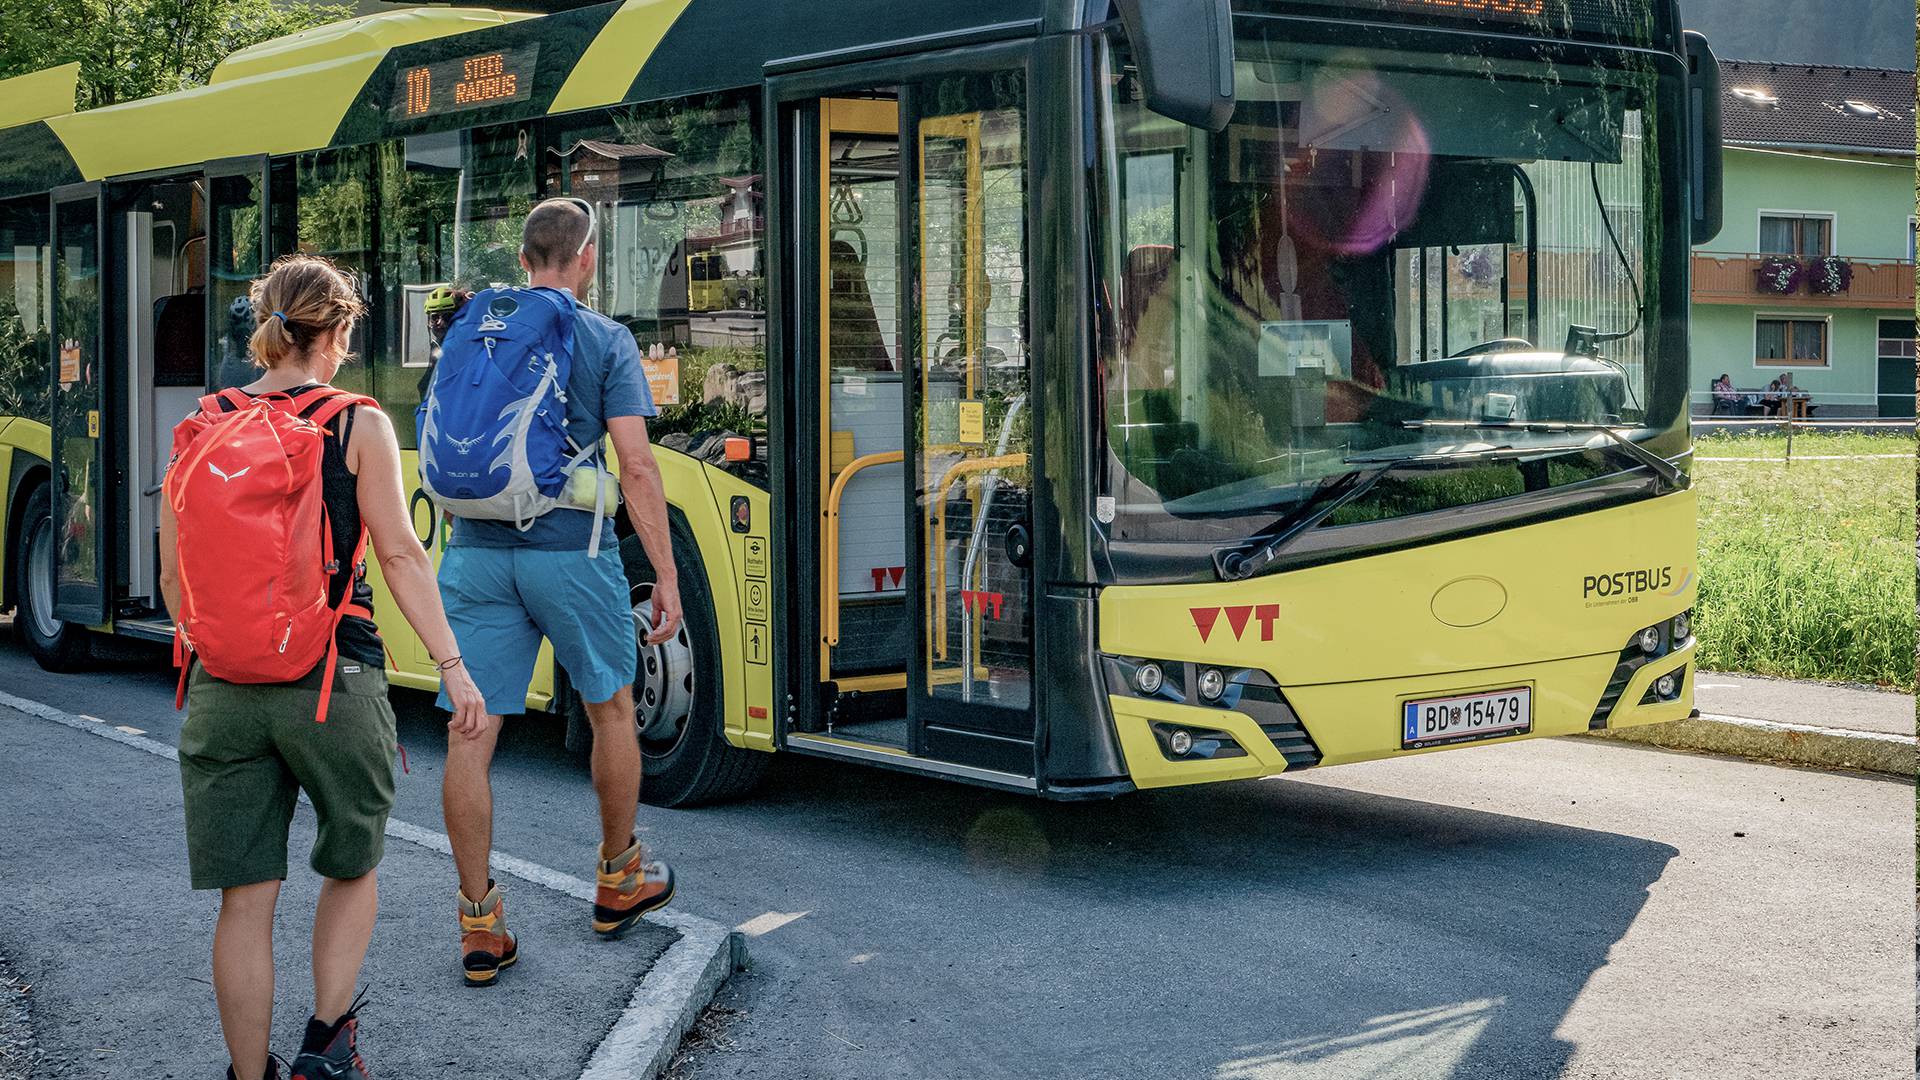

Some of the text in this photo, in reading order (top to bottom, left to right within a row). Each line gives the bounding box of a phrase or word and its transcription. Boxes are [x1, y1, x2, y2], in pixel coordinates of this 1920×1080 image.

[464, 54, 503, 80] STEEG
[407, 68, 430, 115] 110
[455, 74, 517, 104] RADBUS
[1583, 566, 1671, 598] POSTBUS
[960, 591, 1003, 620] VVT
[1189, 604, 1280, 644] VVT
[1426, 696, 1519, 732] BD 15479
[1409, 726, 1415, 735] A
